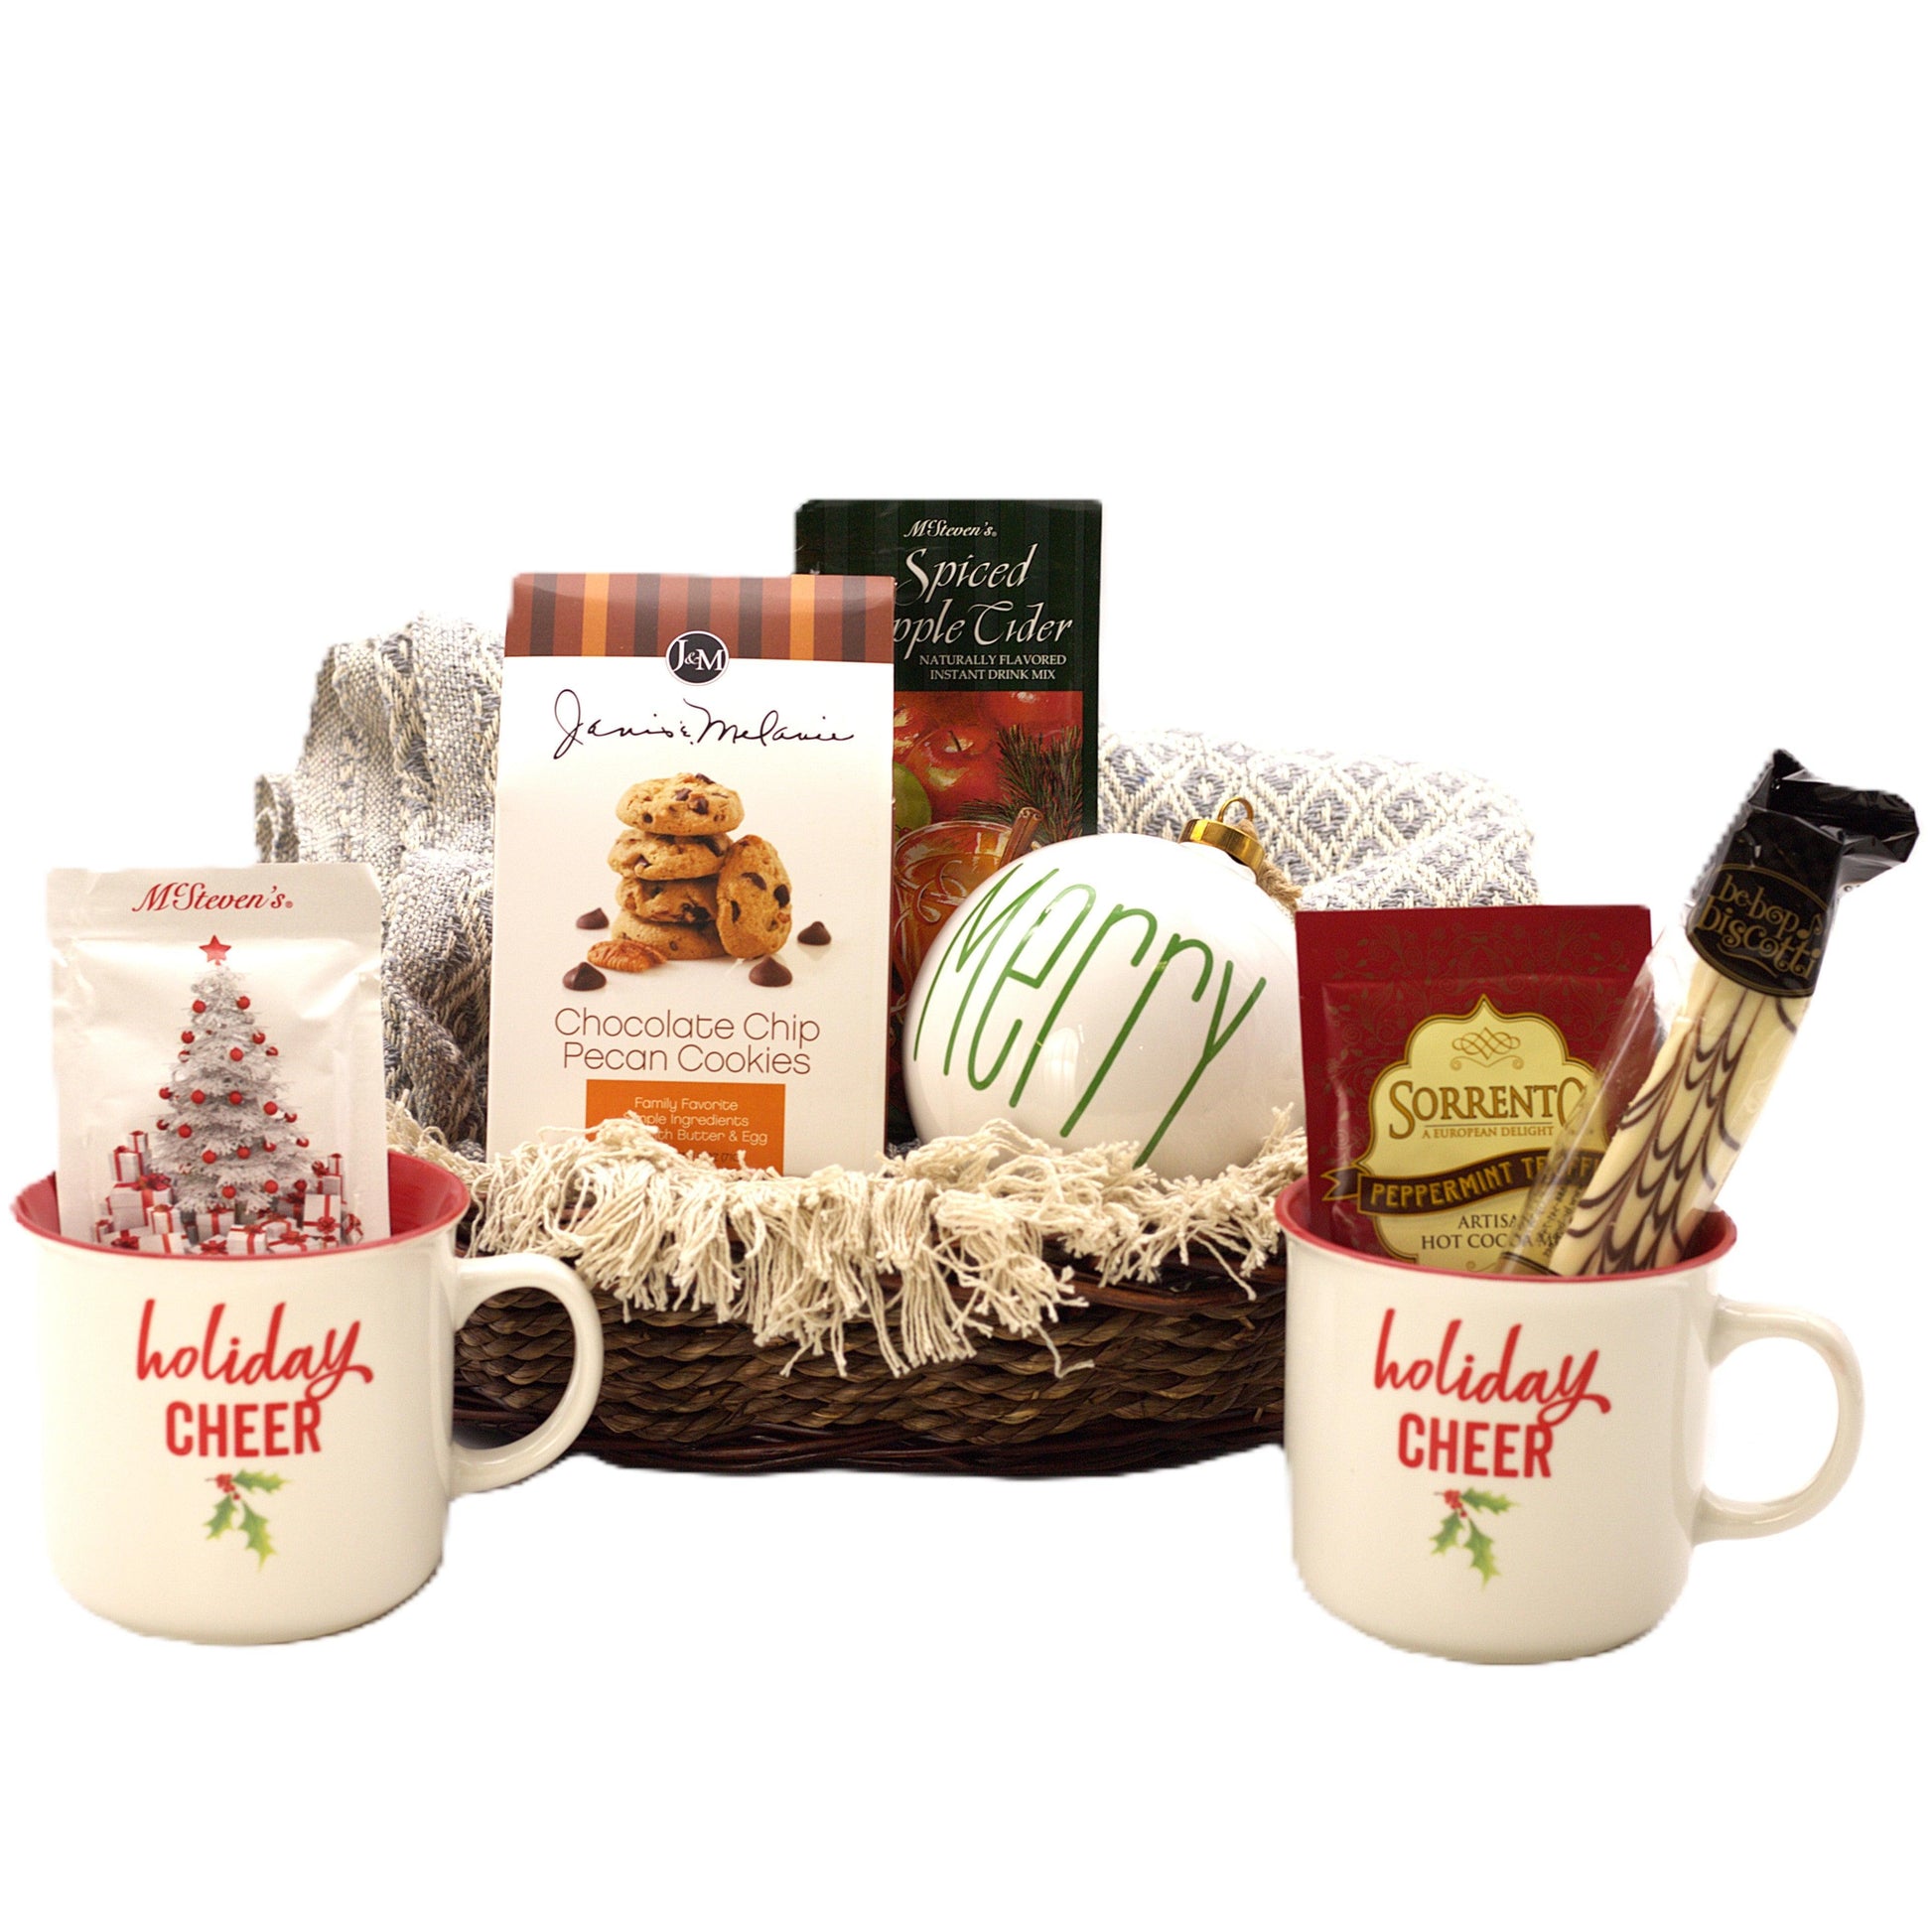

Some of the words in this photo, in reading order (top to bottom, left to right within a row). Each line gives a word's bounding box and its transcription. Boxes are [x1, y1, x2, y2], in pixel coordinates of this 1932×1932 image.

[897, 543, 1038, 606] Spiced
[894, 598, 965, 660] pple
[968, 600, 1073, 646] Cider
[673, 638, 726, 672] J&M
[919, 654, 997, 666] NATURALLY
[998, 654, 1067, 666] FLAVORED
[930, 668, 987, 680] INSTANT
[988, 668, 1030, 680] DRINK
[1031, 669, 1056, 680] MIX
[1696, 895, 1823, 979] biscotti
[555, 1007, 735, 1039] Chocolate
[743, 1011, 821, 1049] Chip
[912, 861, 1267, 1170] Merry
[563, 1041, 668, 1071] Pecan
[677, 1043, 812, 1075] Cookies
[634, 1097, 677, 1113] Family
[681, 1097, 739, 1111] Favorite
[670, 1113, 750, 1129] Ingredients
[677, 1129, 726, 1142] Butter
[728, 1130, 738, 1143] &
[742, 1130, 768, 1147] Egg
[1422, 1129, 1432, 1140] A
[1433, 1127, 1498, 1139] EUROPEAN
[1500, 1126, 1555, 1138] DELIGHT
[1370, 1161, 1513, 1209] PEPPERMINT
[1421, 1234, 1462, 1250] HOT
[136, 1297, 374, 1404] holiday
[1374, 1307, 1611, 1428] holiday
[165, 1400, 322, 1457] CHEER
[1398, 1411, 1554, 1479] CHEER
